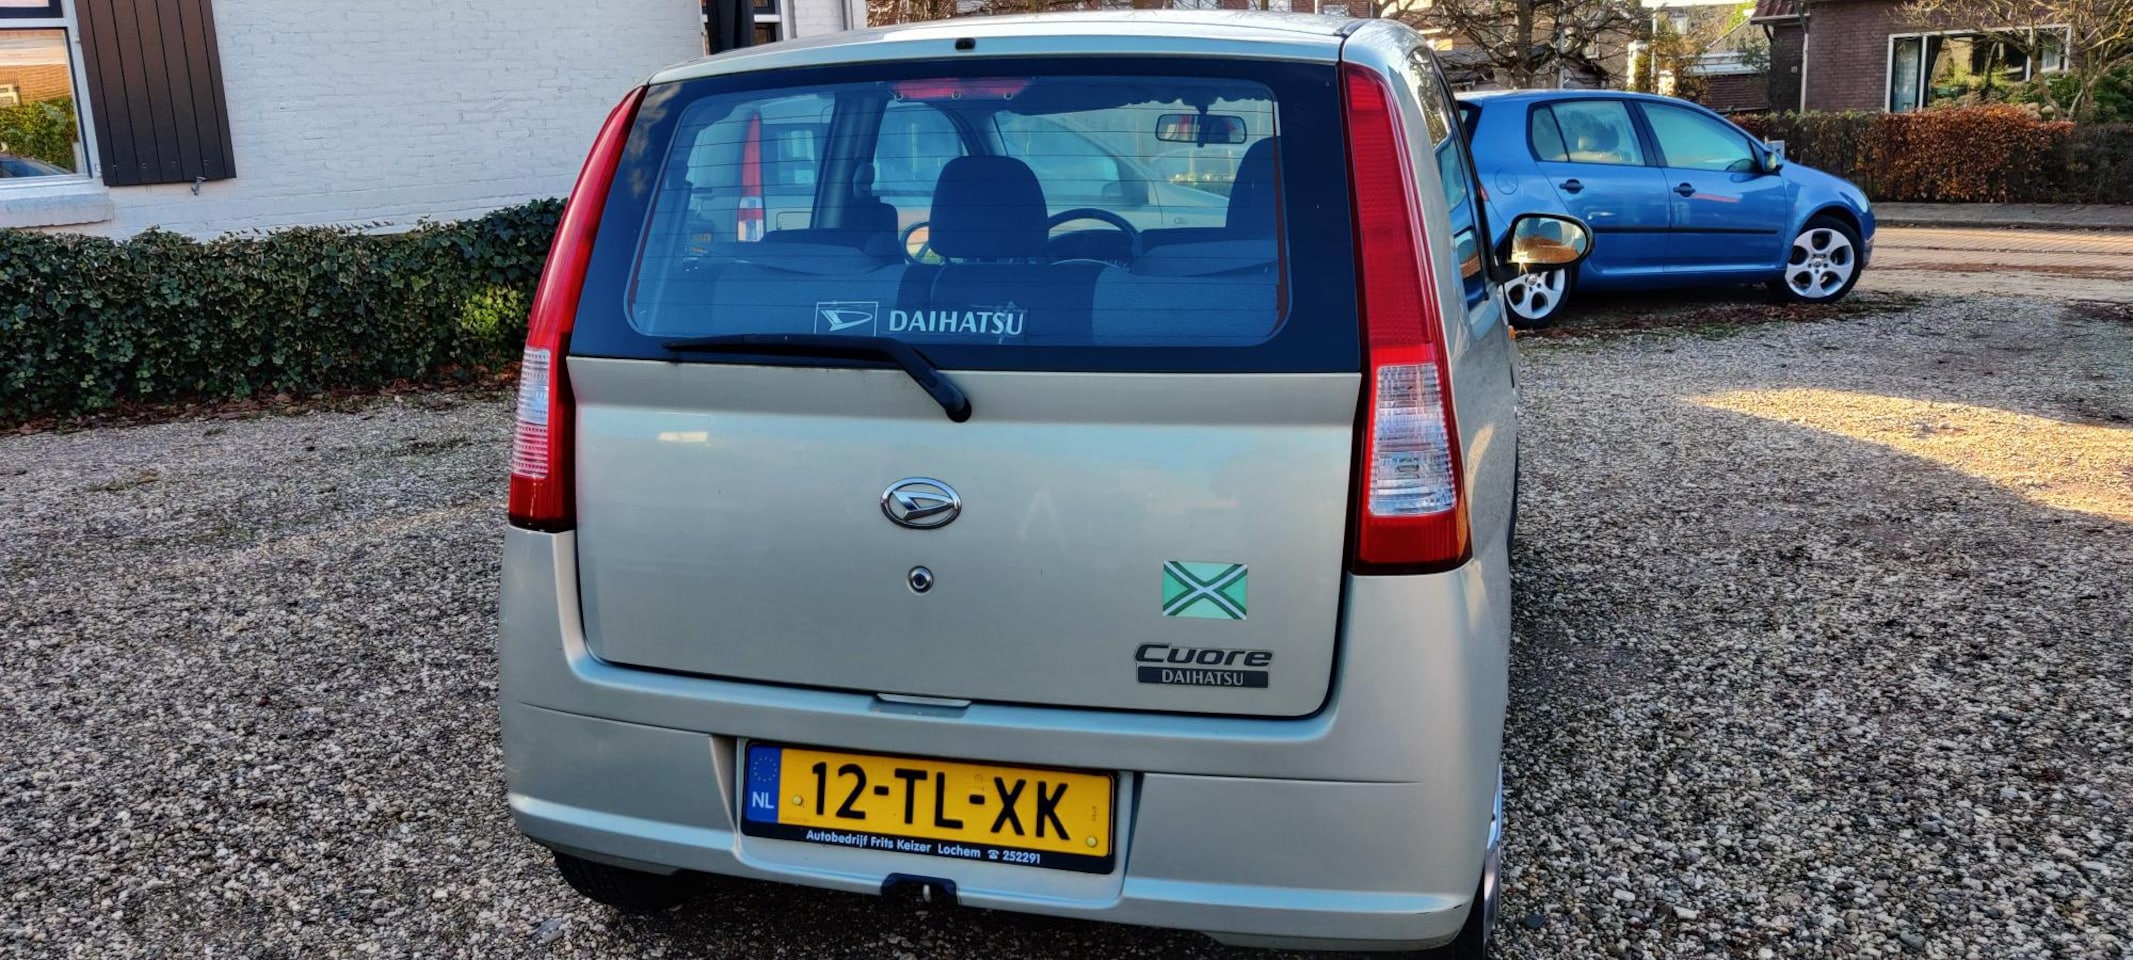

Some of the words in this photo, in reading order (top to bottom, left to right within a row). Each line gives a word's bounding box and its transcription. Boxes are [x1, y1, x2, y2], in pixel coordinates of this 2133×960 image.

[888, 310, 1024, 336] DAIHATSU
[1135, 643, 1273, 667] Cuore
[1161, 669, 1244, 686] DAIHATSU
[752, 791, 775, 809] NL
[811, 761, 1071, 841] 12-TL-XK
[806, 830, 868, 848] Autobedrijf
[870, 836, 894, 849] Frits
[896, 839, 932, 853] Keizer
[938, 843, 980, 858] Lochem
[1002, 849, 1041, 864] 252291
